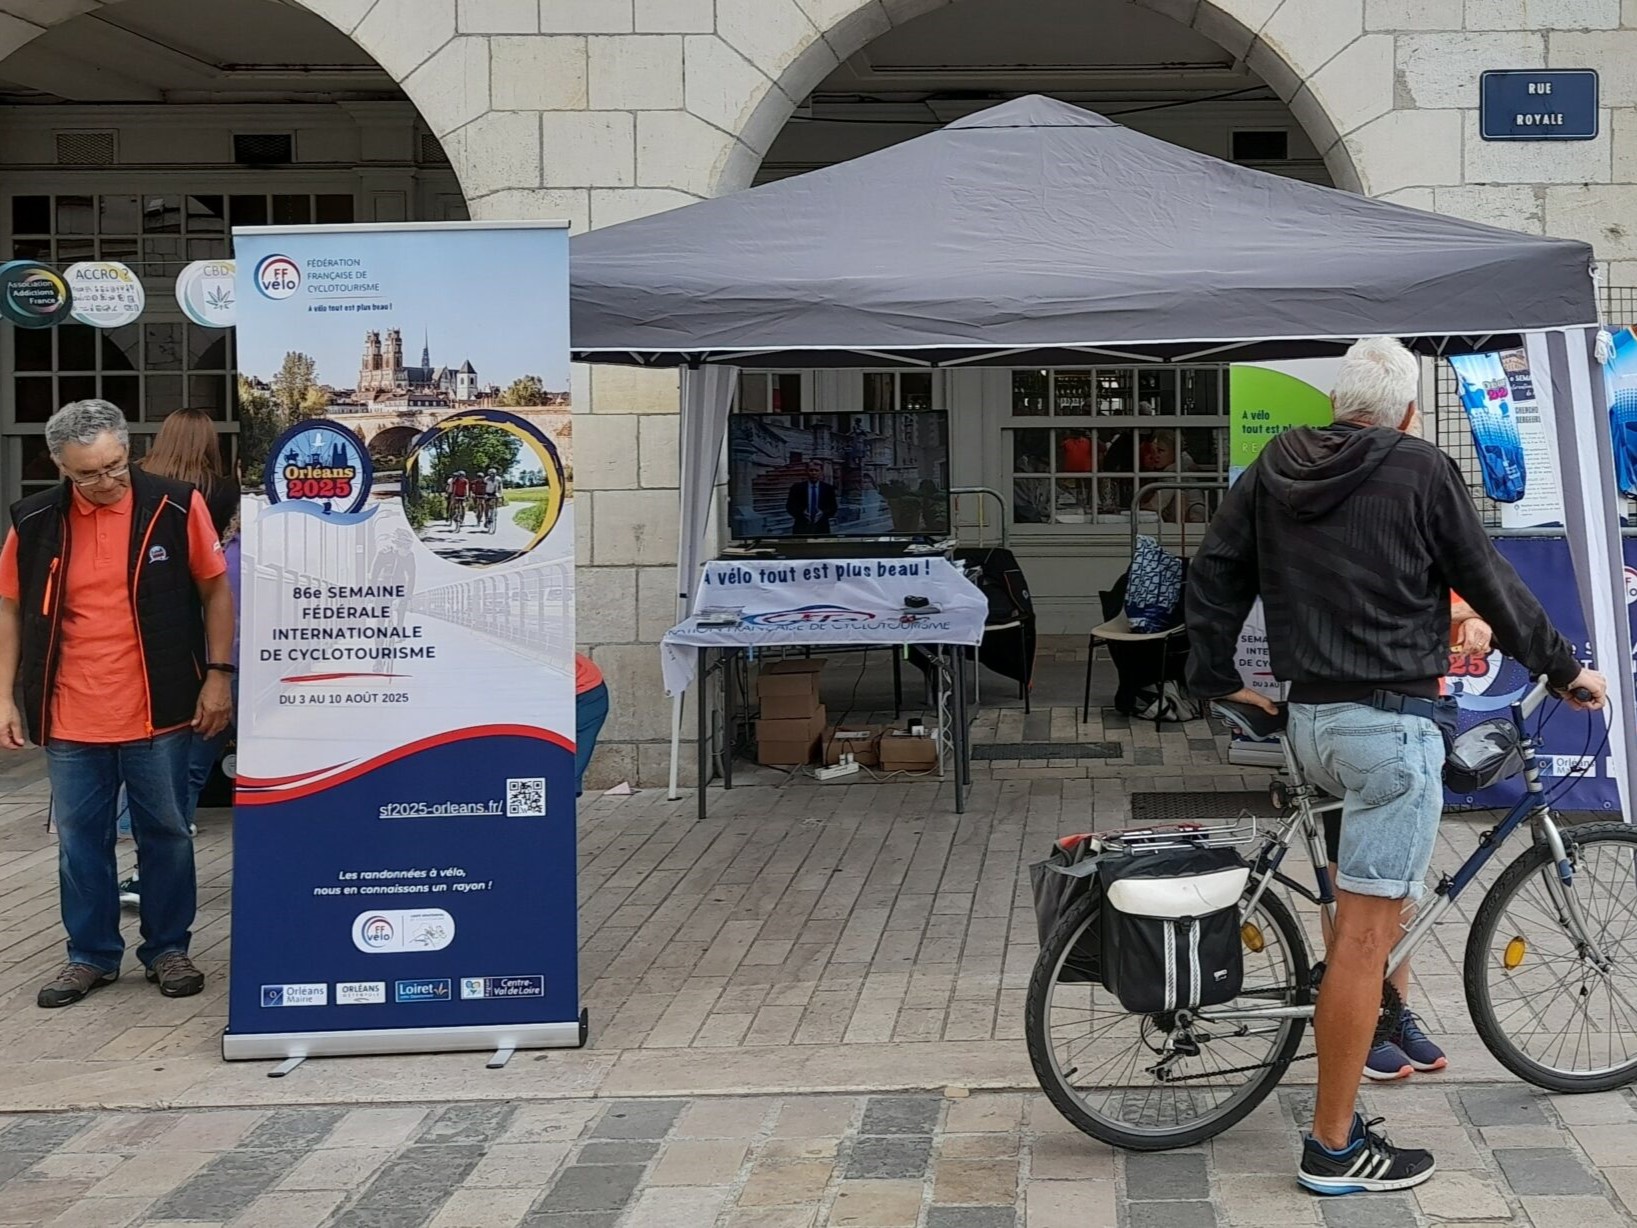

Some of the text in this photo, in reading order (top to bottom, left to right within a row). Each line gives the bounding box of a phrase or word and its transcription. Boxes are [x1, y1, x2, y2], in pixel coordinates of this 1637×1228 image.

[1528, 83, 1551, 94] RUE
[1516, 114, 1563, 125] ROYALE
[306, 258, 360, 268] FÉDÉRATION
[75, 268, 129, 280] ACCRO ?
[203, 265, 229, 277] CBD
[274, 268, 288, 279] FF
[307, 271, 368, 281] FRANÇAISE DE
[262, 277, 296, 290] vélo
[307, 283, 380, 293] CYCLOTOURISME
[29, 297, 56, 305] France
[356, 303, 371, 312] plus
[372, 303, 388, 311] beau
[1251, 409, 1270, 421] vélo
[1242, 424, 1263, 434] tout
[1265, 424, 1280, 434] est
[284, 465, 354, 480] Orléans
[288, 479, 351, 498] 2025
[718, 566, 752, 586] vélo
[759, 566, 796, 583] tout
[803, 563, 829, 580] est
[835, 562, 871, 582] plus
[877, 561, 919, 578] beau
[925, 559, 930, 576] !
[292, 585, 405, 600] 86e SEMAINE
[302, 604, 391, 620] FÉDÉRALE
[272, 626, 423, 641] INTERNATIONALE
[260, 646, 436, 662] DE CYCLOTOURISME
[1239, 659, 1253, 667] DE
[279, 691, 409, 705] DU 3 AU 10 AOÛT 2025
[379, 800, 503, 817] sf2025-orleans.fr/
[339, 867, 467, 880] Les randonnées à vélo,
[313, 880, 493, 895] nous en connaissons un rayon !
[375, 926, 386, 934] FF
[501, 978, 533, 987] Centre-
[286, 986, 325, 996] Orléans
[342, 984, 380, 994] ORLÉANS
[400, 984, 433, 995] Loiret
[494, 986, 540, 995] Val de Loire
